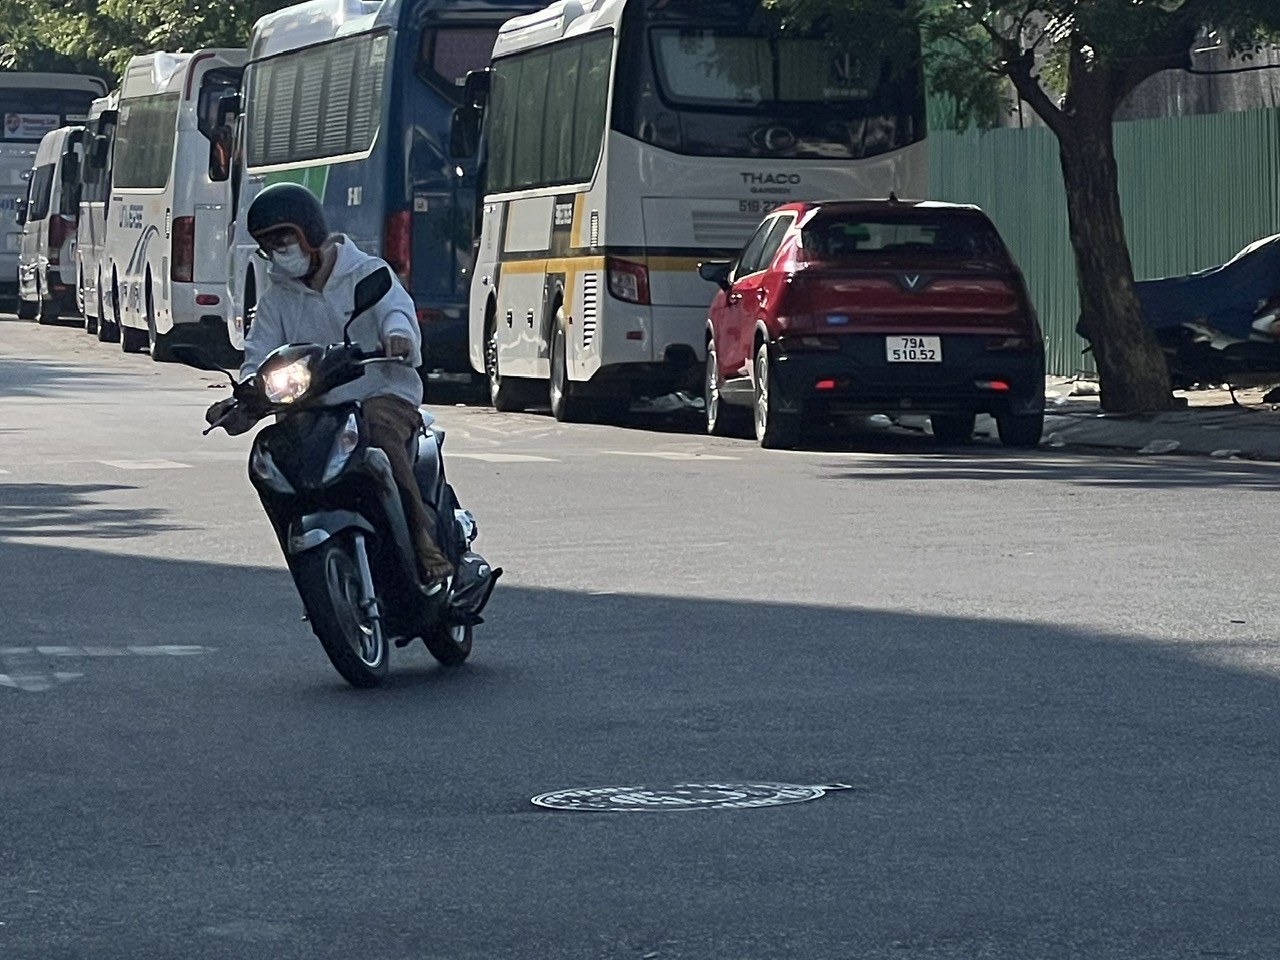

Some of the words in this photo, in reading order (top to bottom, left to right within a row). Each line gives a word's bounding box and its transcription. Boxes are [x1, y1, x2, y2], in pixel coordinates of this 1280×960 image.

[740, 172, 801, 185] THACO
[901, 337, 925, 349] 79A
[892, 349, 936, 360] 510.52
